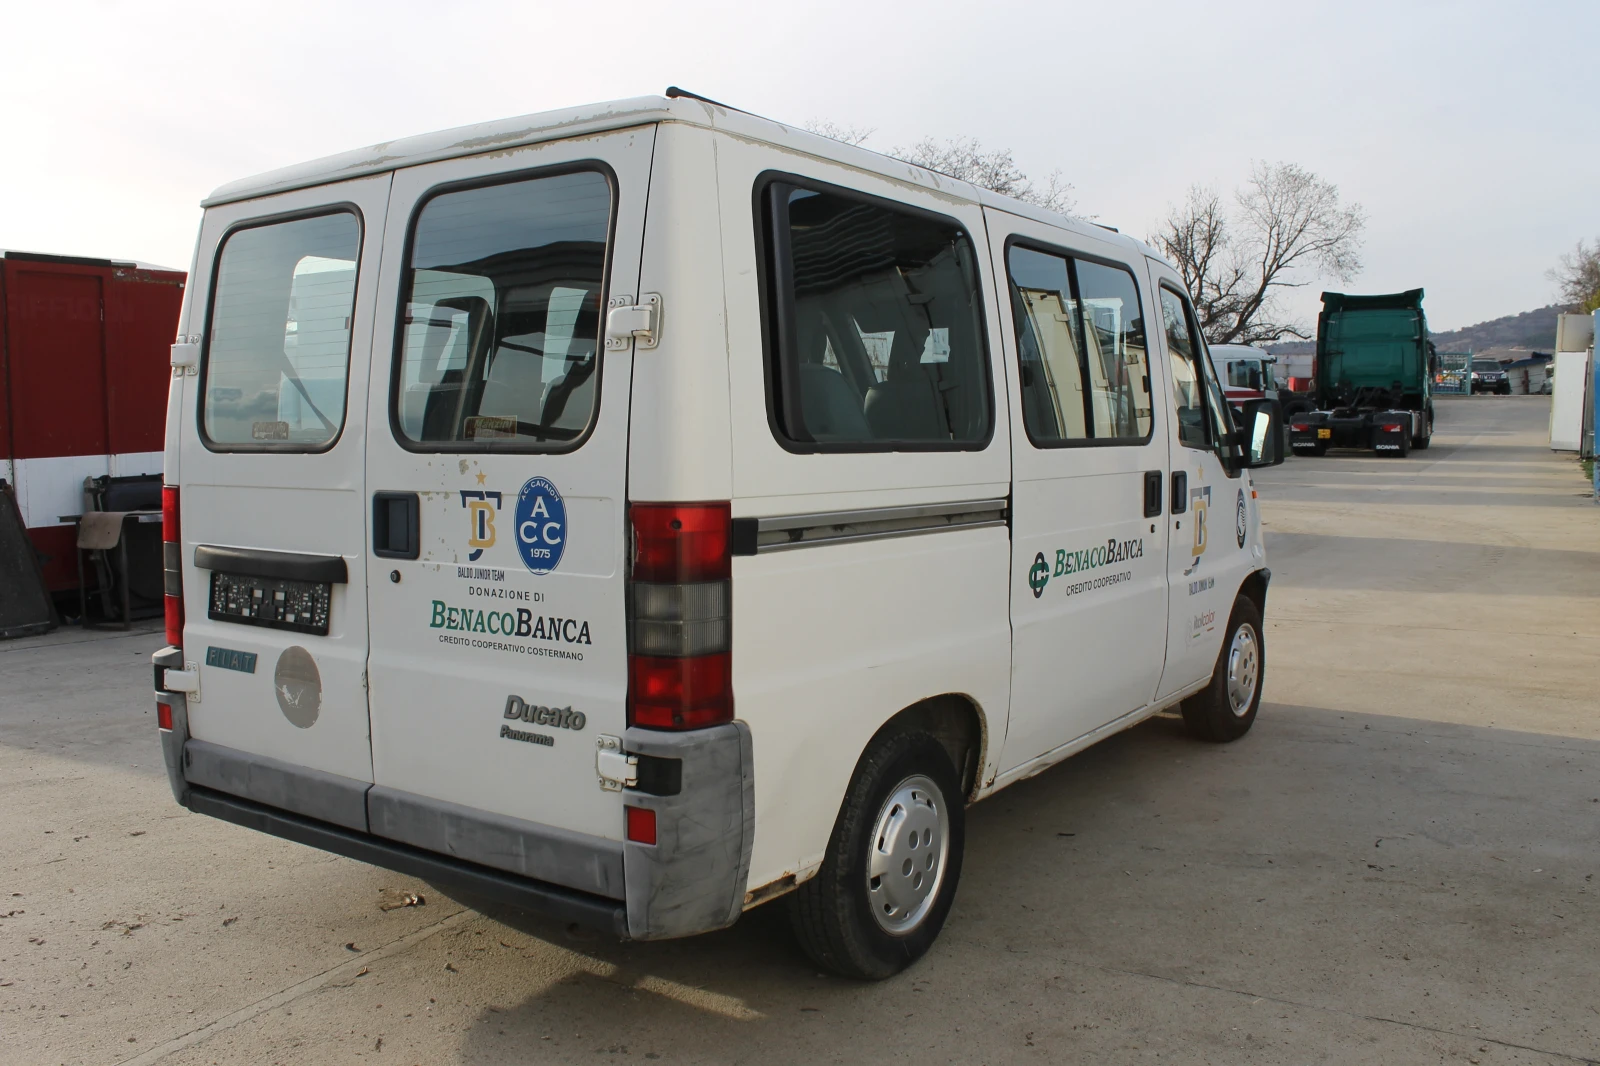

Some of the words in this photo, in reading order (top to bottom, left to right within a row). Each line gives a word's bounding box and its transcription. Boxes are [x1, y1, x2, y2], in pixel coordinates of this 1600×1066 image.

[530, 480, 560, 502] CAVAION
[530, 496, 550, 518] A
[530, 548, 551, 559] 1975
[457, 566, 474, 579] BALDO
[473, 567, 491, 581] JUNIOR
[491, 569, 505, 582] TEAM
[1066, 580, 1092, 596] CREDITO
[1093, 571, 1132, 589] COOPERATIVO
[468, 586, 530, 601] DONAZIONE
[533, 592, 545, 602] DI
[439, 634, 470, 647] CREDITO
[471, 639, 525, 654] COOPERATIVO
[527, 646, 584, 661] COSTERMANO
[209, 649, 251, 669] FIAT
[503, 694, 586, 731] Ducato
[500, 724, 555, 747] Panorama
